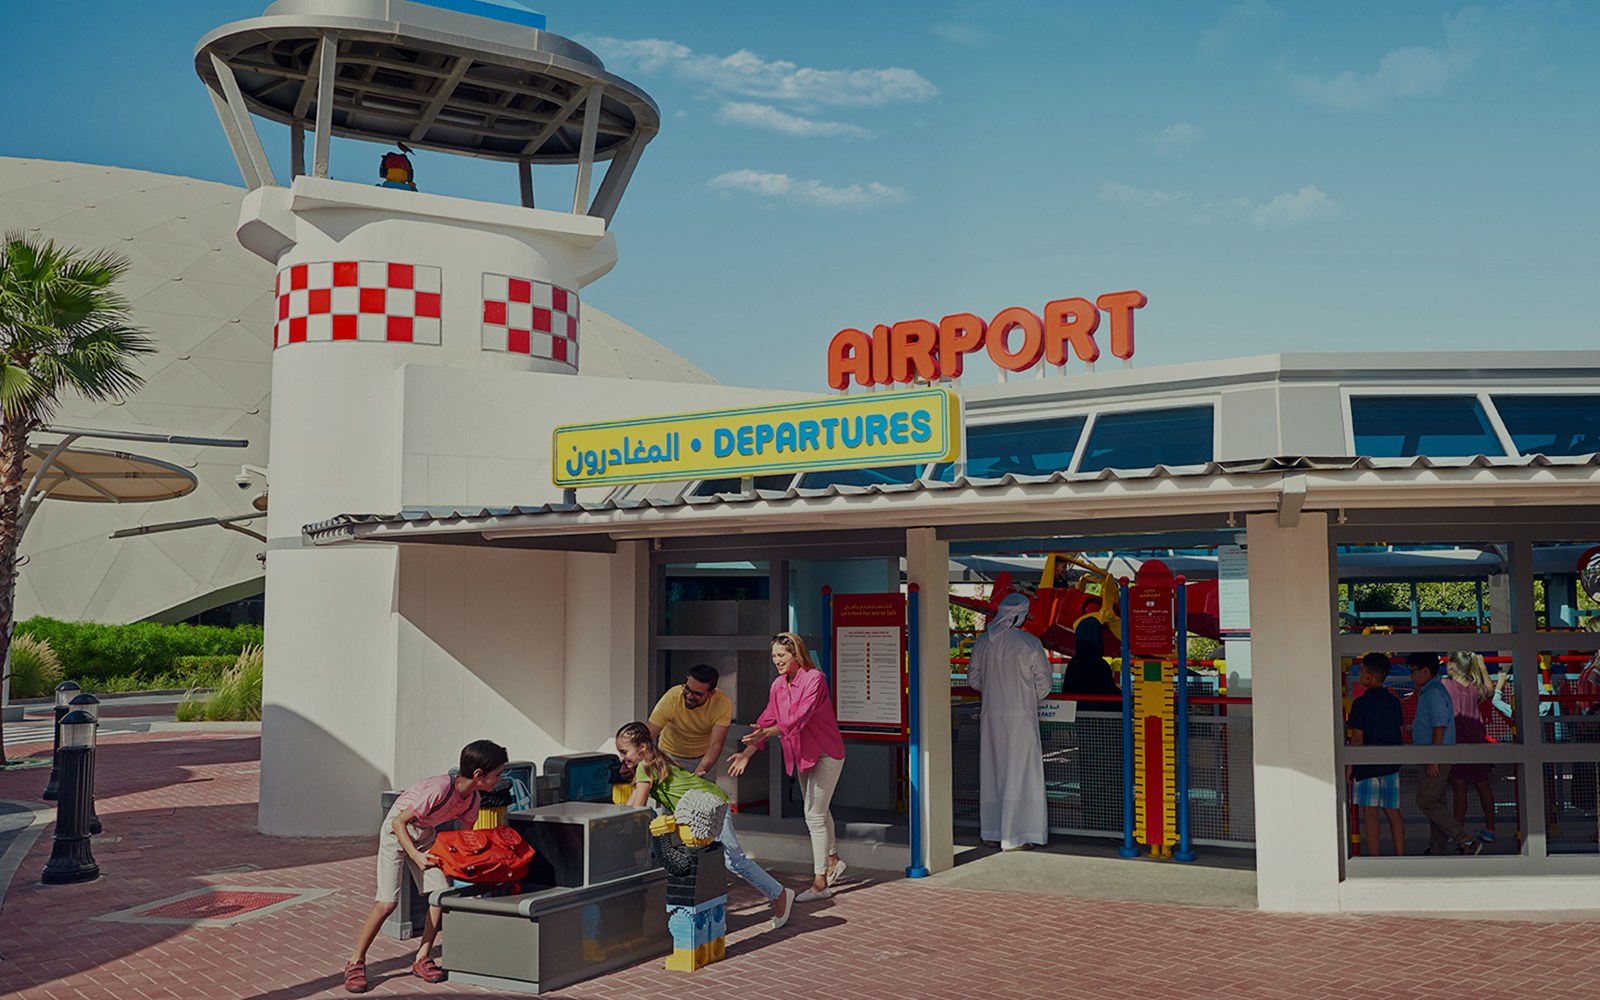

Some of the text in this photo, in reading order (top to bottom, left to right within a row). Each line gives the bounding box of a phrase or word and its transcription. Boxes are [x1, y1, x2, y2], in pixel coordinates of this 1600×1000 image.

[828, 290, 1147, 390] AIRPORT
[566, 431, 679, 476] المغادرون
[713, 409, 932, 457] DEPARTURES
